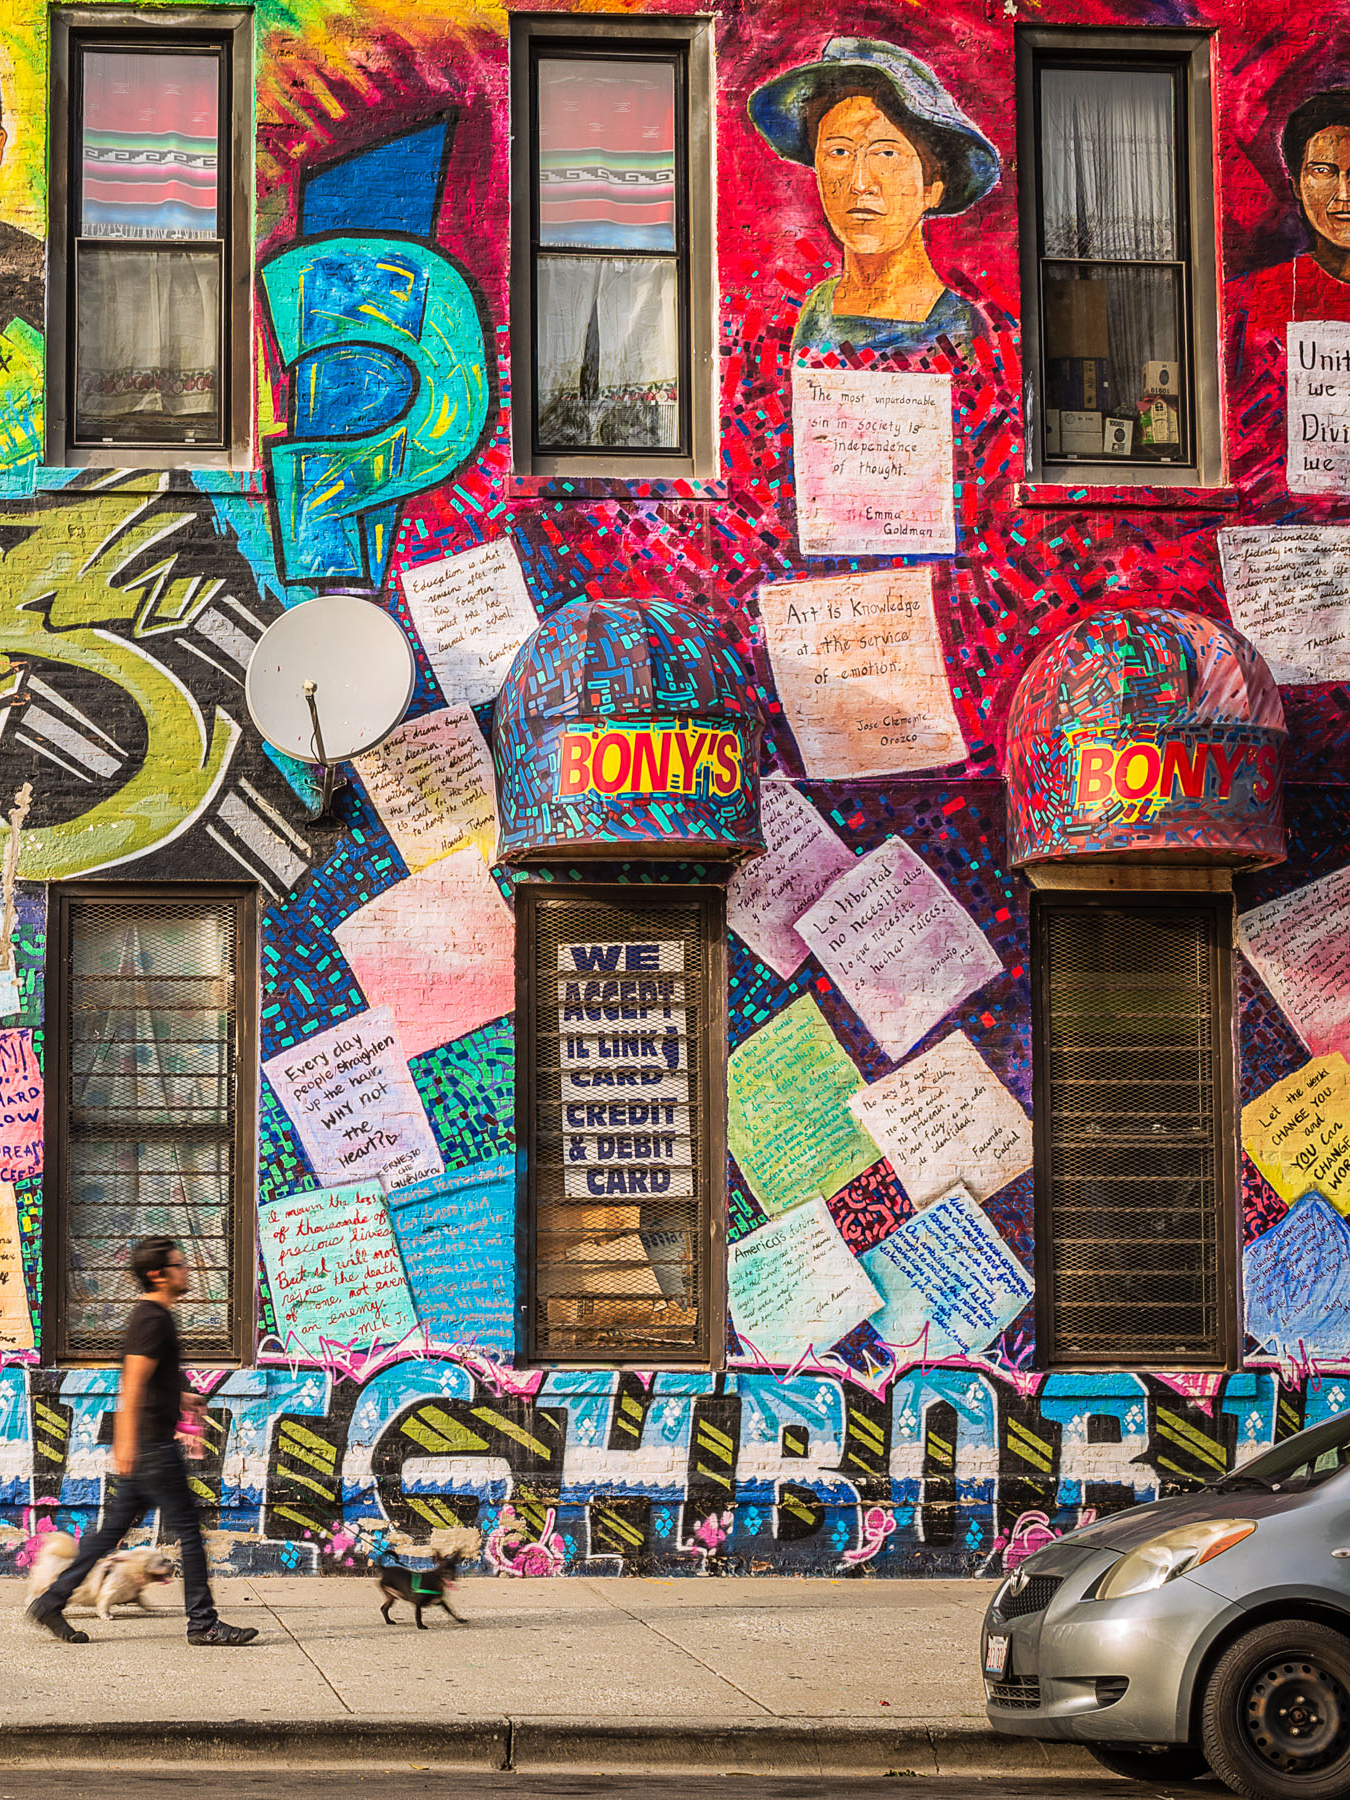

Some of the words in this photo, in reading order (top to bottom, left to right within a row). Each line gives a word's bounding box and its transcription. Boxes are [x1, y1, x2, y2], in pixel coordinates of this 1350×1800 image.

[841, 393, 865, 403] most
[875, 396, 936, 407] unpardonable
[811, 418, 829, 428] sin
[837, 417, 847, 429] in
[857, 420, 901, 437] society
[908, 422, 922, 434] is
[833, 438, 918, 455] independence
[833, 460, 845, 474] of
[859, 461, 907, 479] thought.
[866, 506, 901, 521] Emma
[883, 523, 933, 537] Goldman
[787, 604, 818, 624] Art
[827, 604, 842, 619] is
[850, 594, 921, 618] Knowledge
[797, 643, 808, 656] at
[820, 637, 851, 654] the
[860, 631, 909, 649] service
[814, 668, 828, 684] of
[840, 661, 902, 680] emotion.
[856, 719, 879, 731] Jose
[880, 733, 918, 746] Orozco
[559, 732, 738, 796] BONY'S
[1077, 741, 1277, 802] BONY'S
[813, 914, 838, 935] La
[835, 864, 892, 914] libertad
[828, 933, 847, 952] no
[850, 887, 902, 934] necesita
[839, 961, 854, 975] lo
[856, 945, 870, 963] que
[872, 901, 916, 942] necesita
[570, 944, 659, 972] WE
[854, 976, 866, 991] es
[870, 937, 905, 975] hechar
[563, 980, 674, 1021] ACCEPT
[284, 1050, 329, 1082] Every
[333, 1033, 364, 1058] day
[598, 1030, 657, 1059] LINK
[293, 1069, 335, 1102] people
[336, 1035, 395, 1074] straighten
[570, 1066, 664, 1088] CARD
[306, 1098, 321, 1113] up
[324, 1084, 345, 1101] the
[321, 1101, 354, 1131] WHY
[358, 1081, 389, 1106] not
[566, 1098, 678, 1128] CREDIT
[1259, 1105, 1281, 1128] Let
[1286, 1087, 1304, 1105] the
[342, 1119, 374, 1141] the
[1271, 1109, 1310, 1146] CHANGE
[1310, 1087, 1333, 1108] YOU
[1304, 1116, 1326, 1137] and
[338, 1130, 385, 1168] Heart?
[569, 1134, 587, 1162] &
[596, 1131, 675, 1160] DEBIT
[1291, 1144, 1318, 1172] YOU
[397, 1164, 414, 1176] CHE
[586, 1164, 671, 1196] CARD
[334, 1269, 361, 1286] the
[364, 1263, 399, 1280] death
